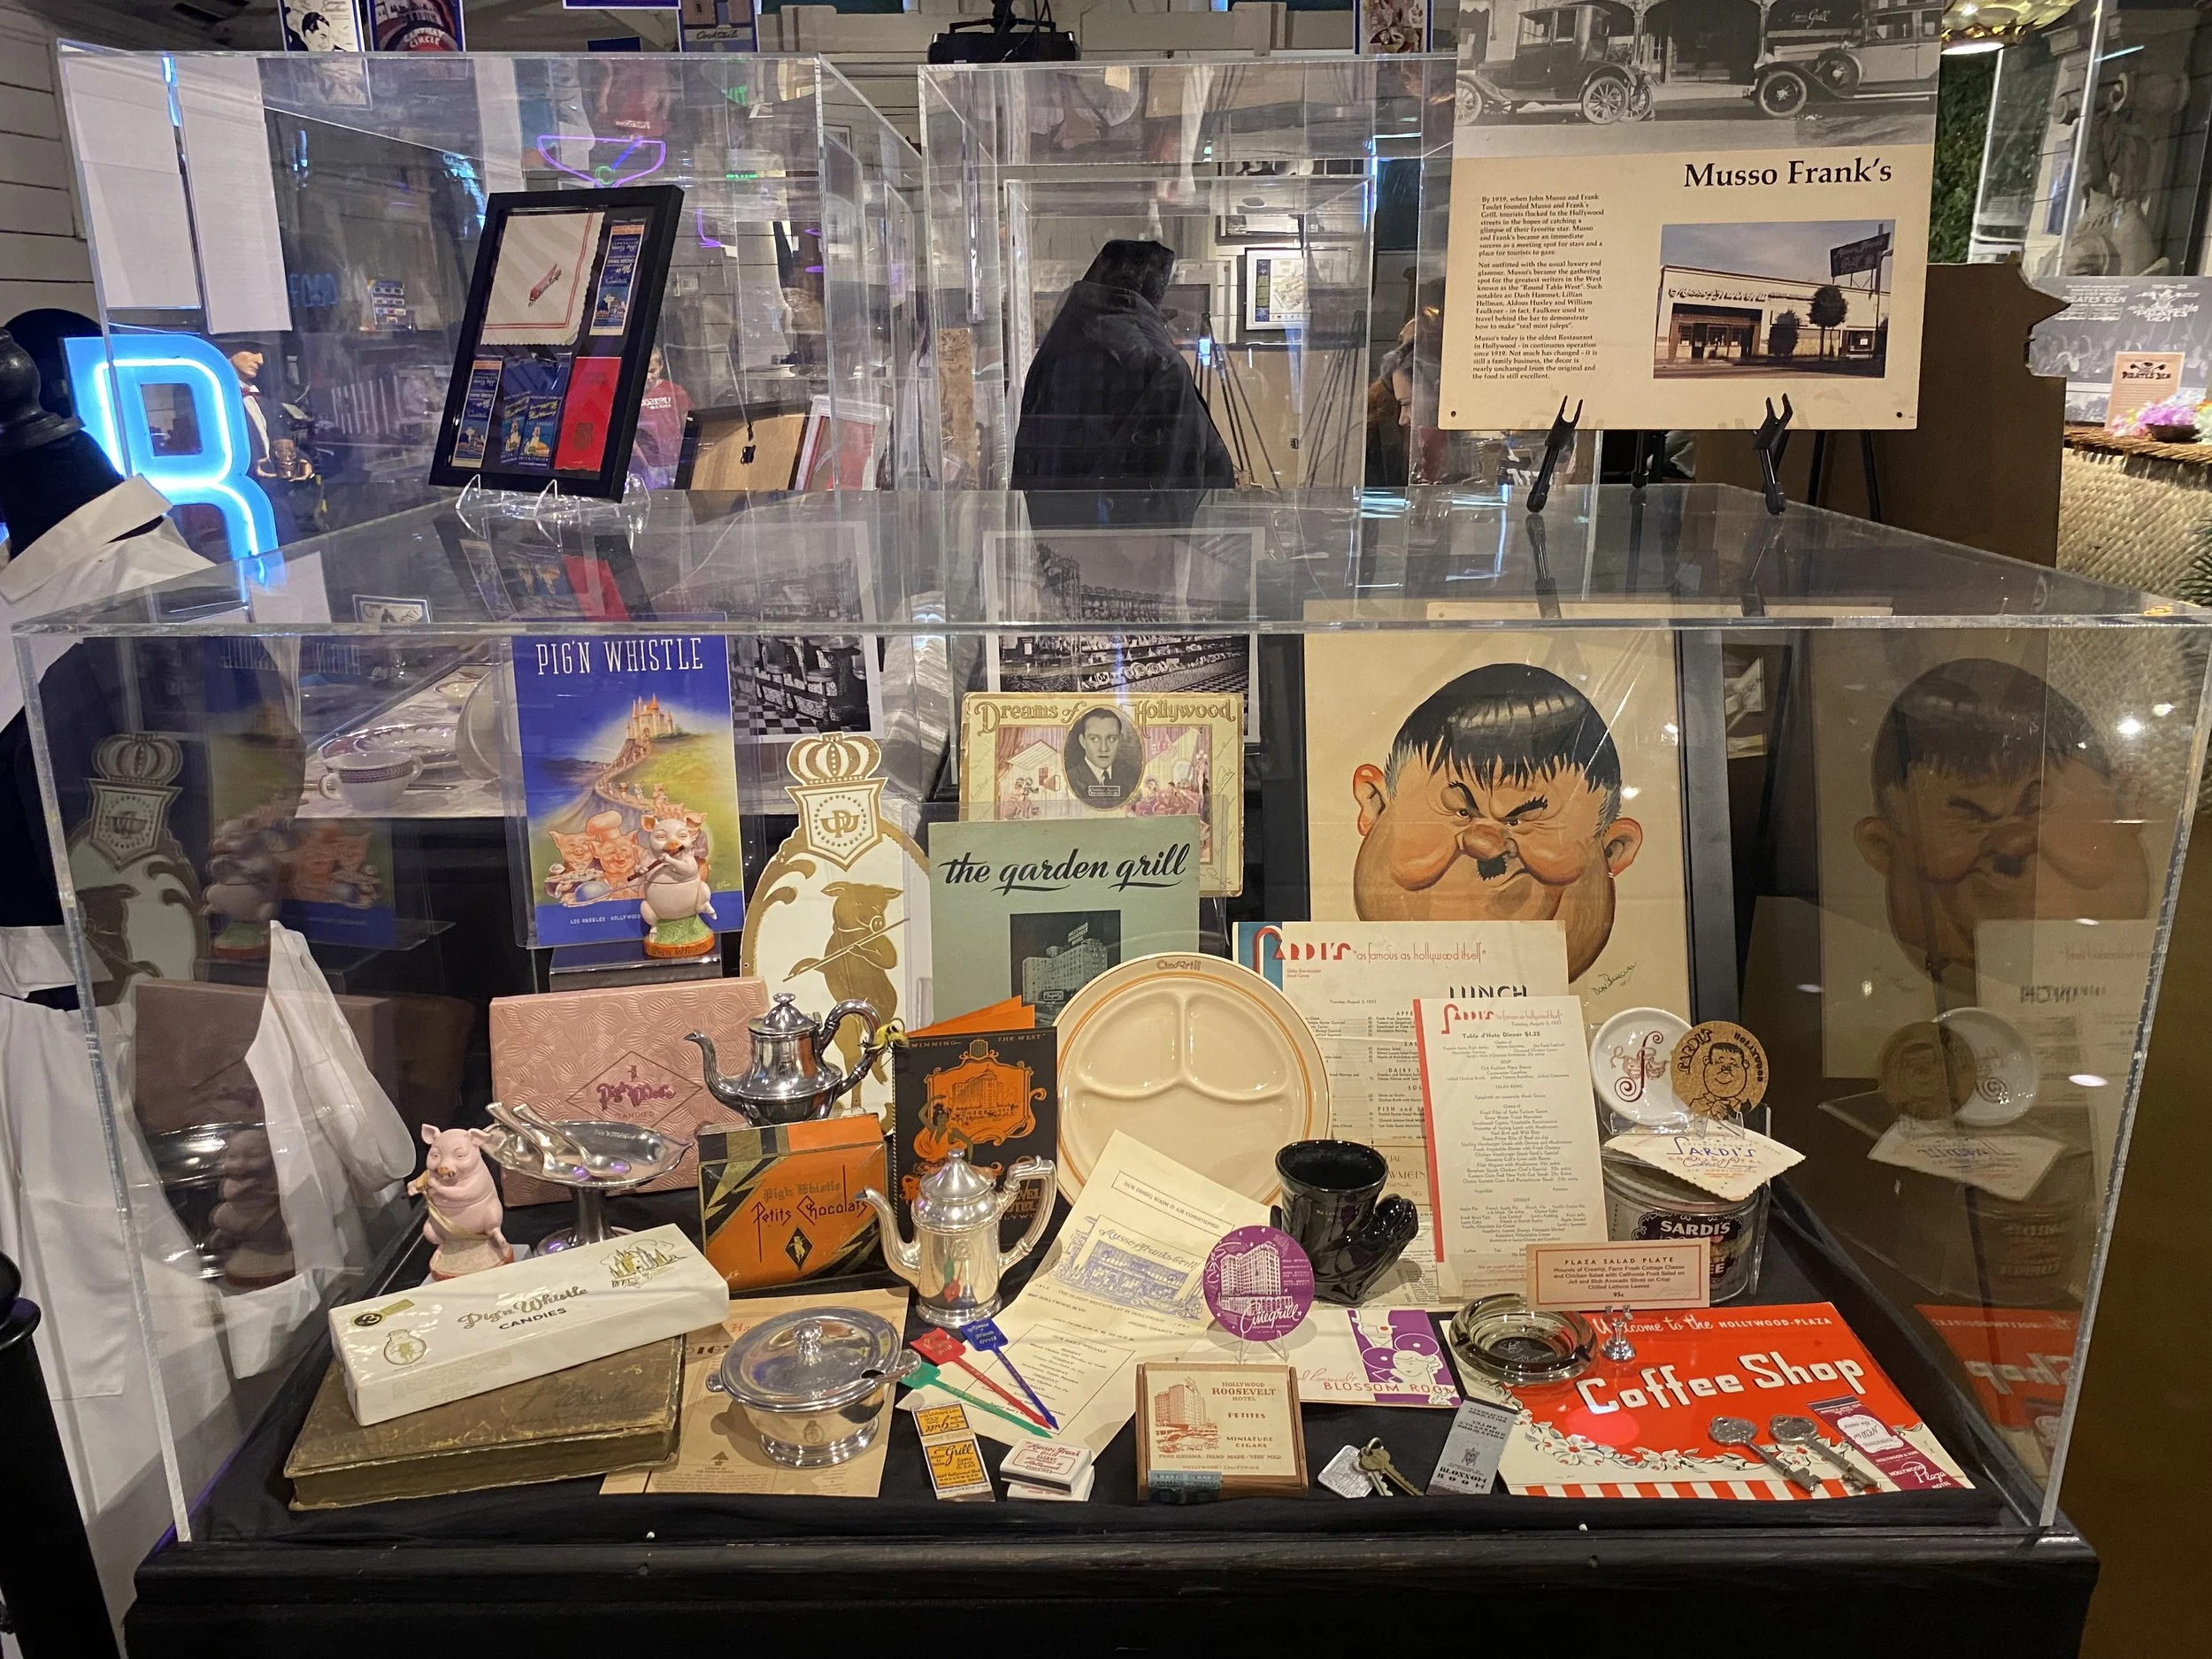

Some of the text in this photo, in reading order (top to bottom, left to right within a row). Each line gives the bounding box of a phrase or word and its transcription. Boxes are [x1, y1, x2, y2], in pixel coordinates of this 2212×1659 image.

[410, 35, 440, 48] CIRCLE
[695, 27, 738, 40] Cocktail
[1684, 157, 1892, 188] Musso Frank's
[536, 638, 703, 675] PIG'N WHISTLE
[974, 698, 1237, 739] Dreams of Hollywood
[938, 843, 1190, 896] the garden grill
[1368, 942, 1398, 964] famous
[1414, 942, 1459, 964] hollywood
[1461, 942, 1486, 963] itself"
[1678, 1028, 1713, 1075] SARDI'S
[626, 1083, 676, 1107] Whistle
[751, 1165, 867, 1263] Petits Chocolats
[1154, 1196, 1170, 1208] ROOM
[1176, 1205, 1185, 1215] AIR
[1185, 1210, 1219, 1229] CONDITIONED
[1661, 1220, 1731, 1235] SARDI'S
[457, 1286, 588, 1329] Pig'n Whistle
[499, 1308, 567, 1330] CANDIES
[1240, 1302, 1300, 1333] Cinegrill
[1663, 1317, 1684, 1331] to
[1685, 1314, 1714, 1331] the
[1718, 1316, 1832, 1330] HOLLYWOOD-PLAZA
[1324, 1381, 1458, 1394] BLOSSOM ROOM
[1578, 1351, 1866, 1416] Coffee Shop
[945, 1443, 973, 1467] Grill
[1057, 1448, 1081, 1456] Frank
[1437, 1472, 1485, 1489] ROOM
[1440, 1467, 1486, 1483] BLOSSOM
[1889, 1465, 1923, 1476] HOLLYWOOD
